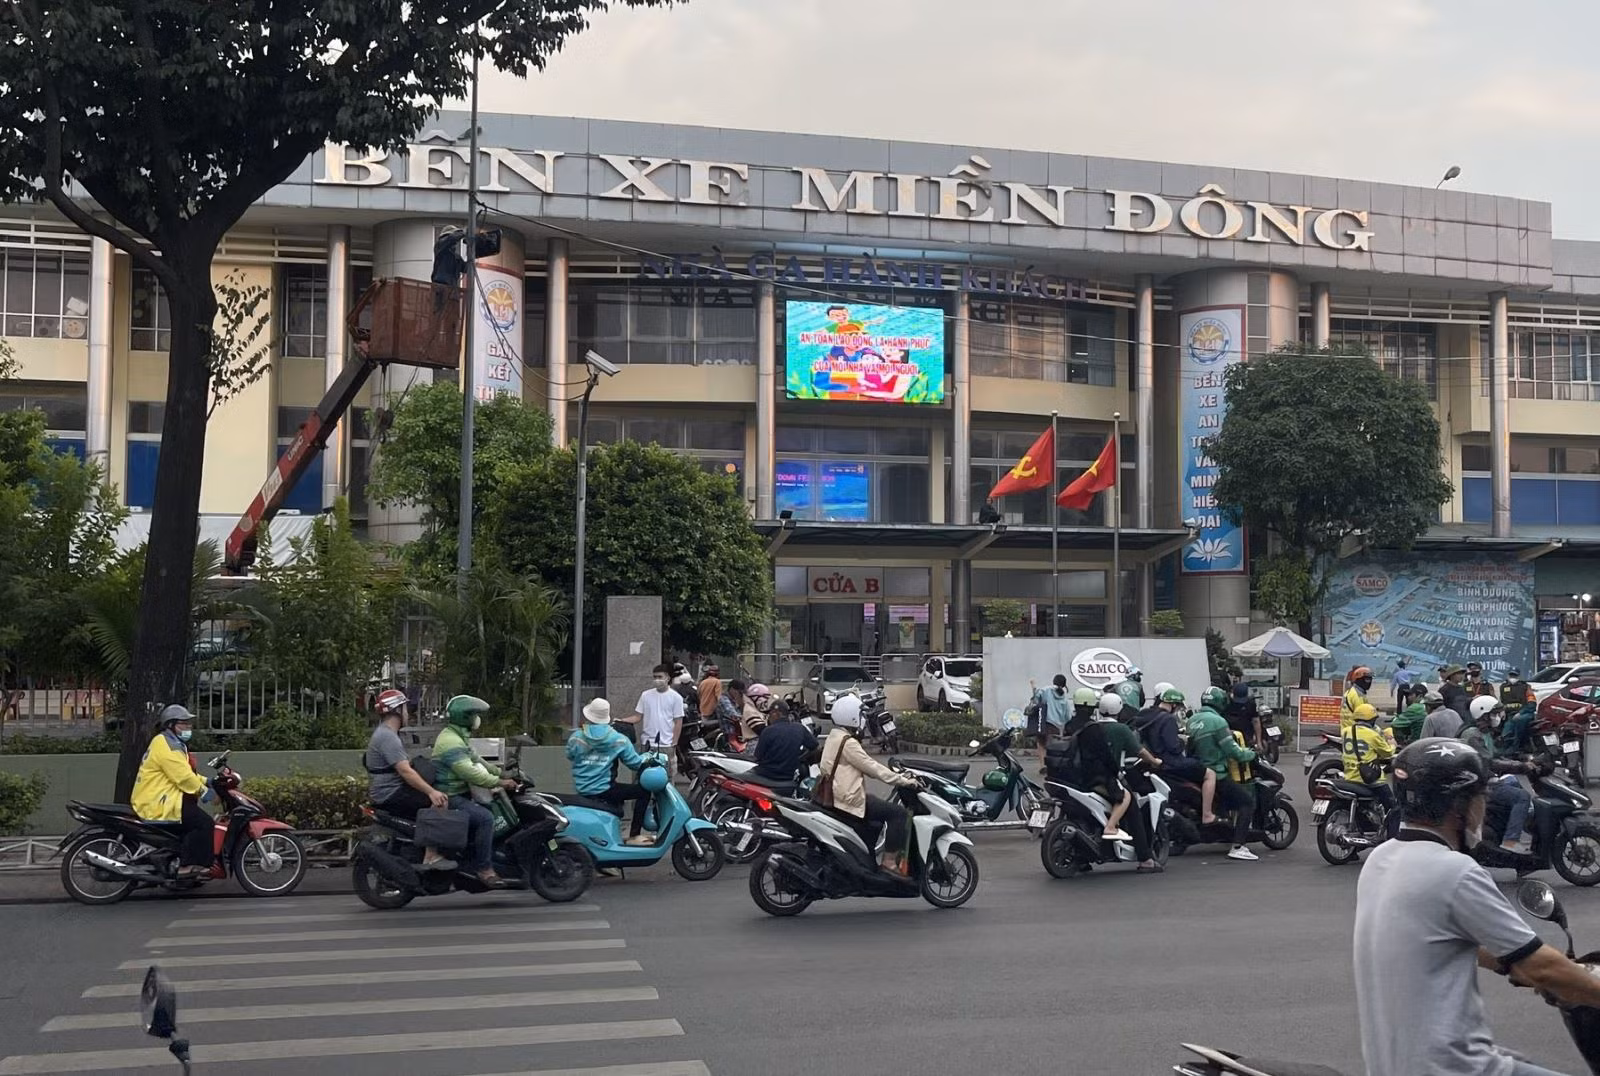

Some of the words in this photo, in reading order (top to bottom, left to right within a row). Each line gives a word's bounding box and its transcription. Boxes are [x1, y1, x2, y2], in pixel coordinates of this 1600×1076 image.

[313, 127, 565, 193] BẾN
[599, 155, 748, 206] XE
[792, 154, 1074, 226] MIỀN
[1105, 183, 1374, 251] ĐÔNG
[638, 246, 733, 280] NHÀ
[747, 251, 808, 281] GA
[822, 252, 944, 289] HÀNH
[961, 265, 1089, 301] KHÁCH
[1193, 371, 1223, 389] BẾN
[1199, 395, 1217, 408] XE
[1198, 414, 1219, 428] AN
[1191, 475, 1221, 488] MIN
[813, 573, 857, 593] CỬA
[865, 577, 880, 592] B
[1356, 577, 1388, 588] SAMCO
